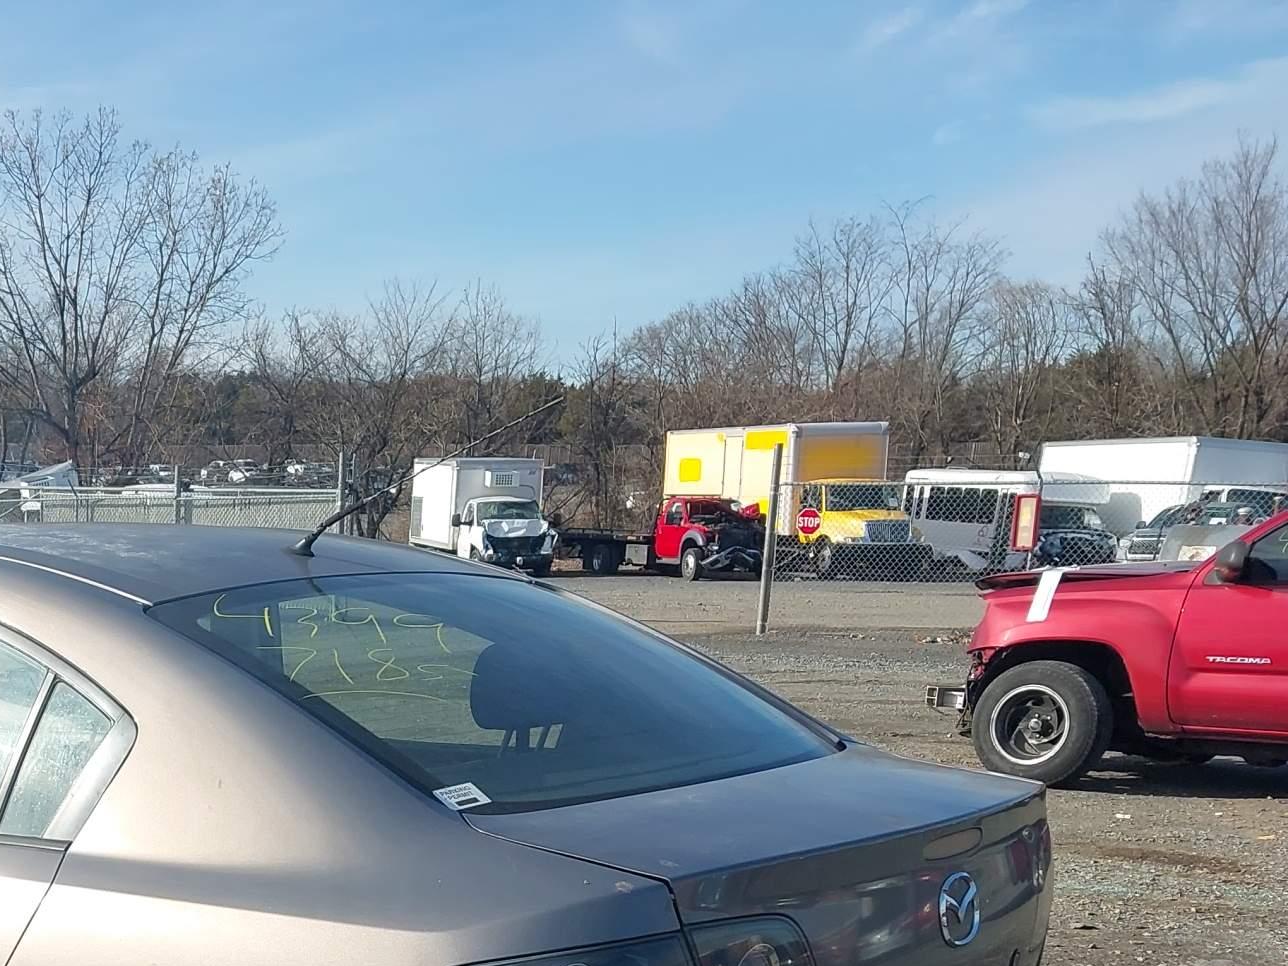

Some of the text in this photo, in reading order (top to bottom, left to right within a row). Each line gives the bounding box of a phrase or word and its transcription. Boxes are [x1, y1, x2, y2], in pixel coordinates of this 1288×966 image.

[798, 516, 820, 528] STOP
[212, 593, 452, 655] 4399
[255, 645, 480, 685] 7185
[1205, 655, 1272, 665] TACOMA
